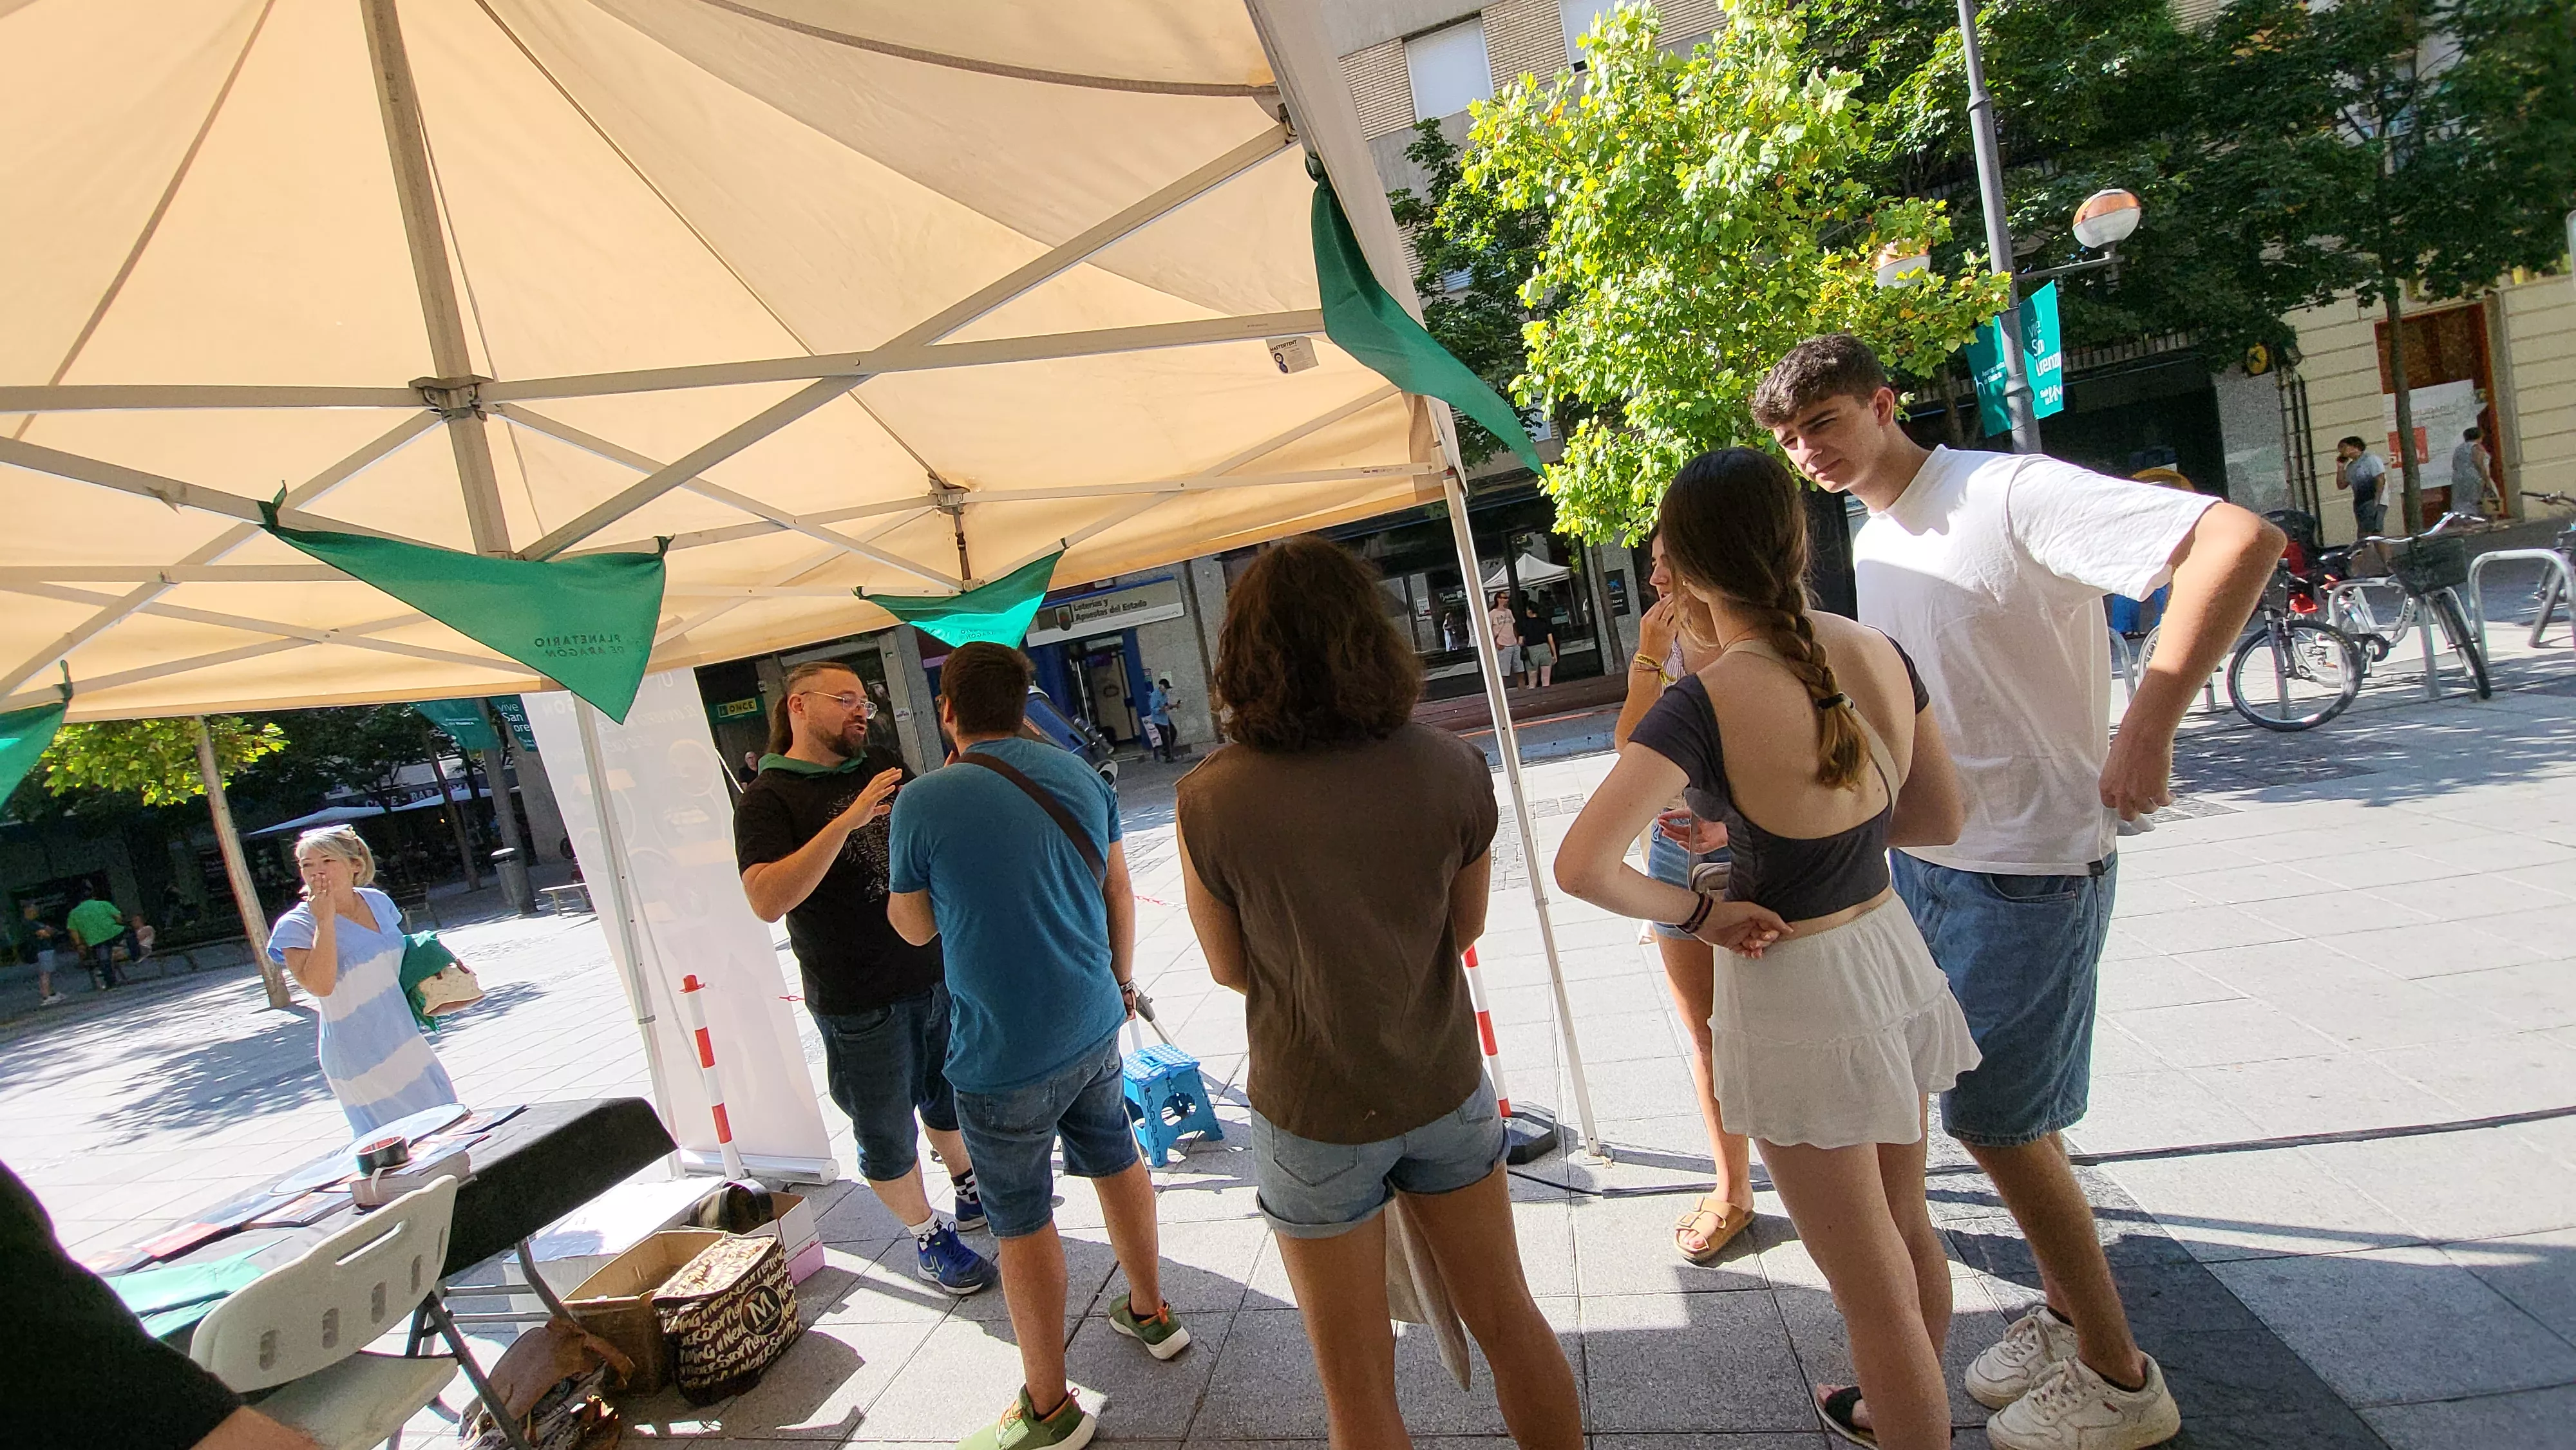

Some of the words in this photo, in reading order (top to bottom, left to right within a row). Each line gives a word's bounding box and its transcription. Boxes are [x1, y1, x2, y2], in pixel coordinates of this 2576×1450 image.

[1076, 609, 1108, 622] Apuestas
[1110, 605, 1121, 614] del
[1122, 599, 1147, 611] Estado
[497, 701, 519, 712] vive
[730, 701, 754, 712] ONCE
[502, 712, 524, 722] San
